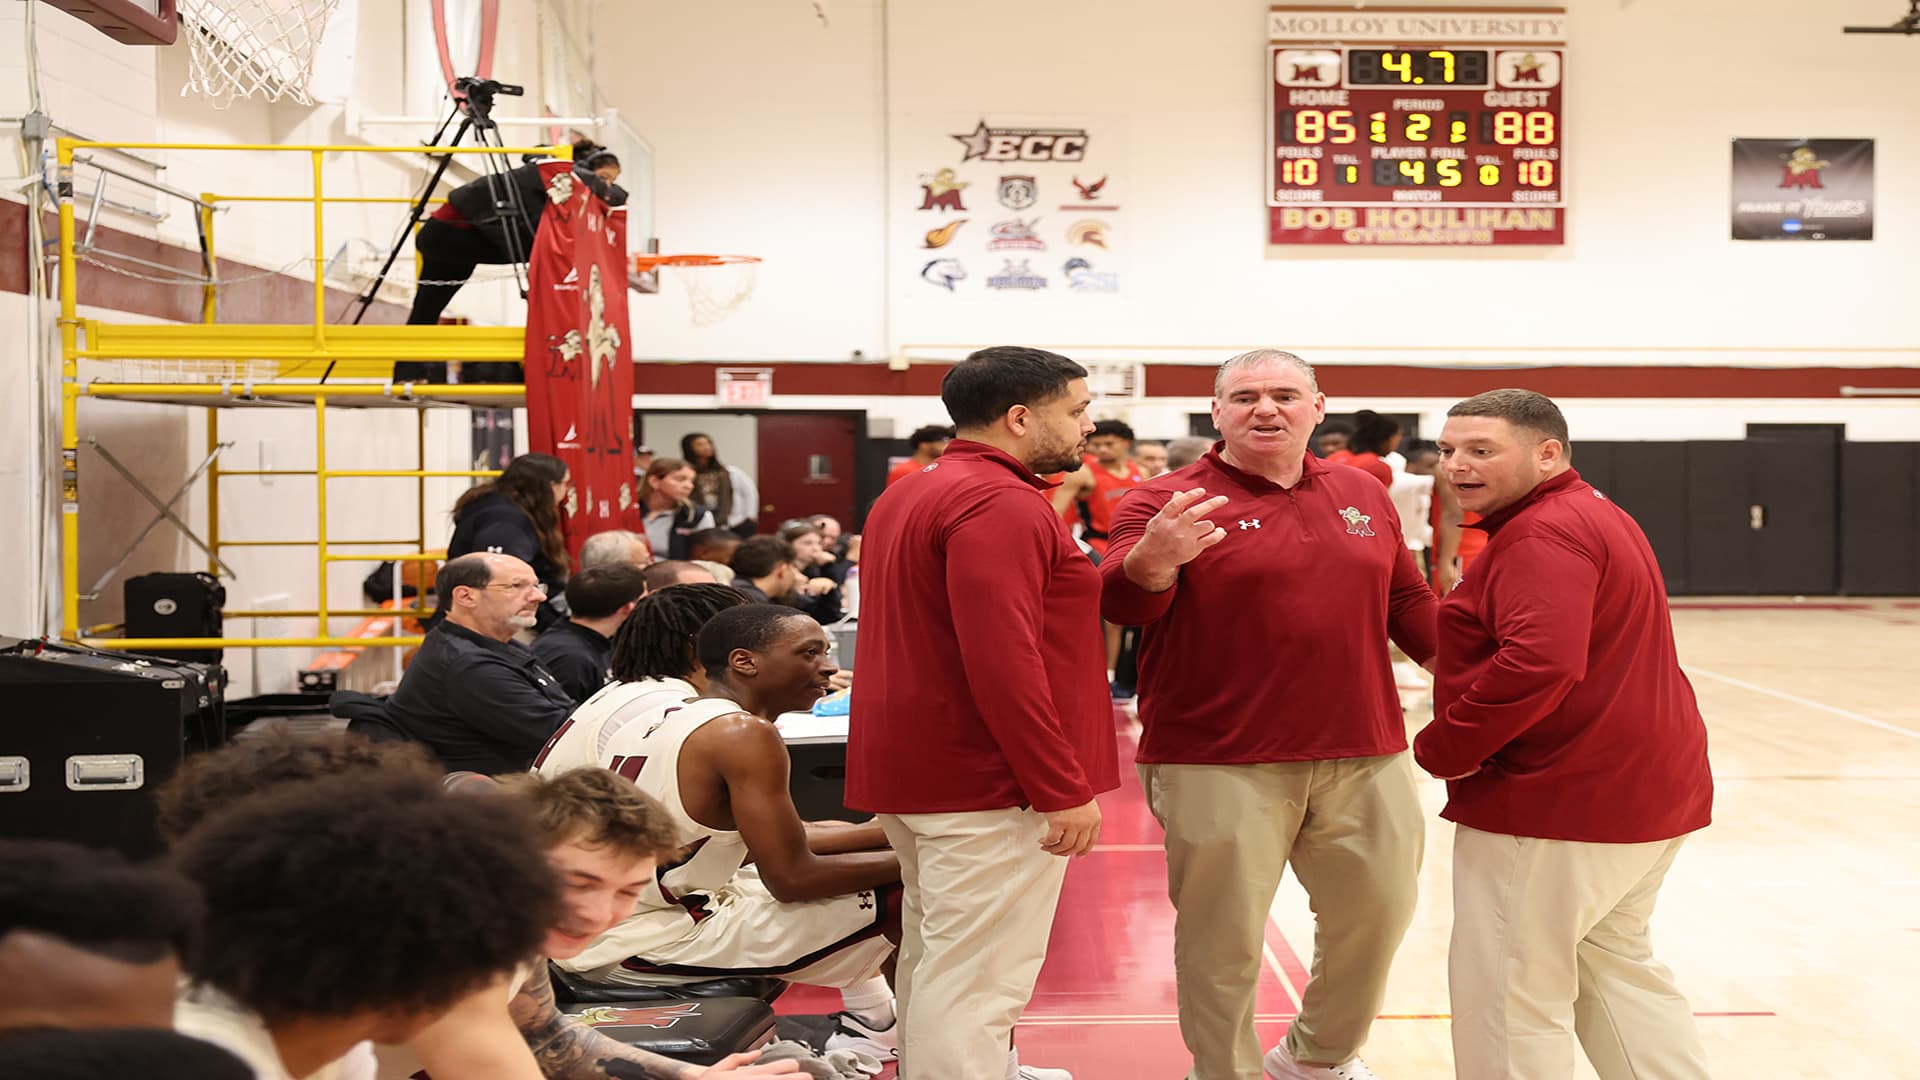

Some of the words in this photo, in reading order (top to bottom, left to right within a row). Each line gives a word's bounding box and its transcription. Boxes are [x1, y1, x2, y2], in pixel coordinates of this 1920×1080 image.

[1273, 18, 1388, 34] MOLLOY
[1398, 18, 1562, 35] UNIVERSITY
[1382, 51, 1455, 84] 4.7
[1289, 90, 1350, 106] HOME
[1392, 98, 1445, 111] PERIOD
[1484, 91, 1551, 107] GUEST
[1295, 110, 1357, 144] 85
[1405, 113, 1432, 142] 2
[1493, 111, 1555, 145] 88
[983, 135, 1087, 161] ECC
[1277, 146, 1323, 158] FOULS
[1371, 146, 1427, 158] PLAYER
[1431, 147, 1468, 159] FOUL
[1513, 148, 1559, 160] FOULS
[1282, 158, 1319, 186] 10
[1518, 159, 1554, 187] 10
[1276, 189, 1323, 201] SCORE
[1392, 190, 1442, 202] MATCH
[1512, 190, 1558, 202] SCORE
[1281, 208, 1356, 229] BOB
[1366, 208, 1555, 230] HOULIHAN
[1342, 228, 1493, 244] GYMNASIUM
